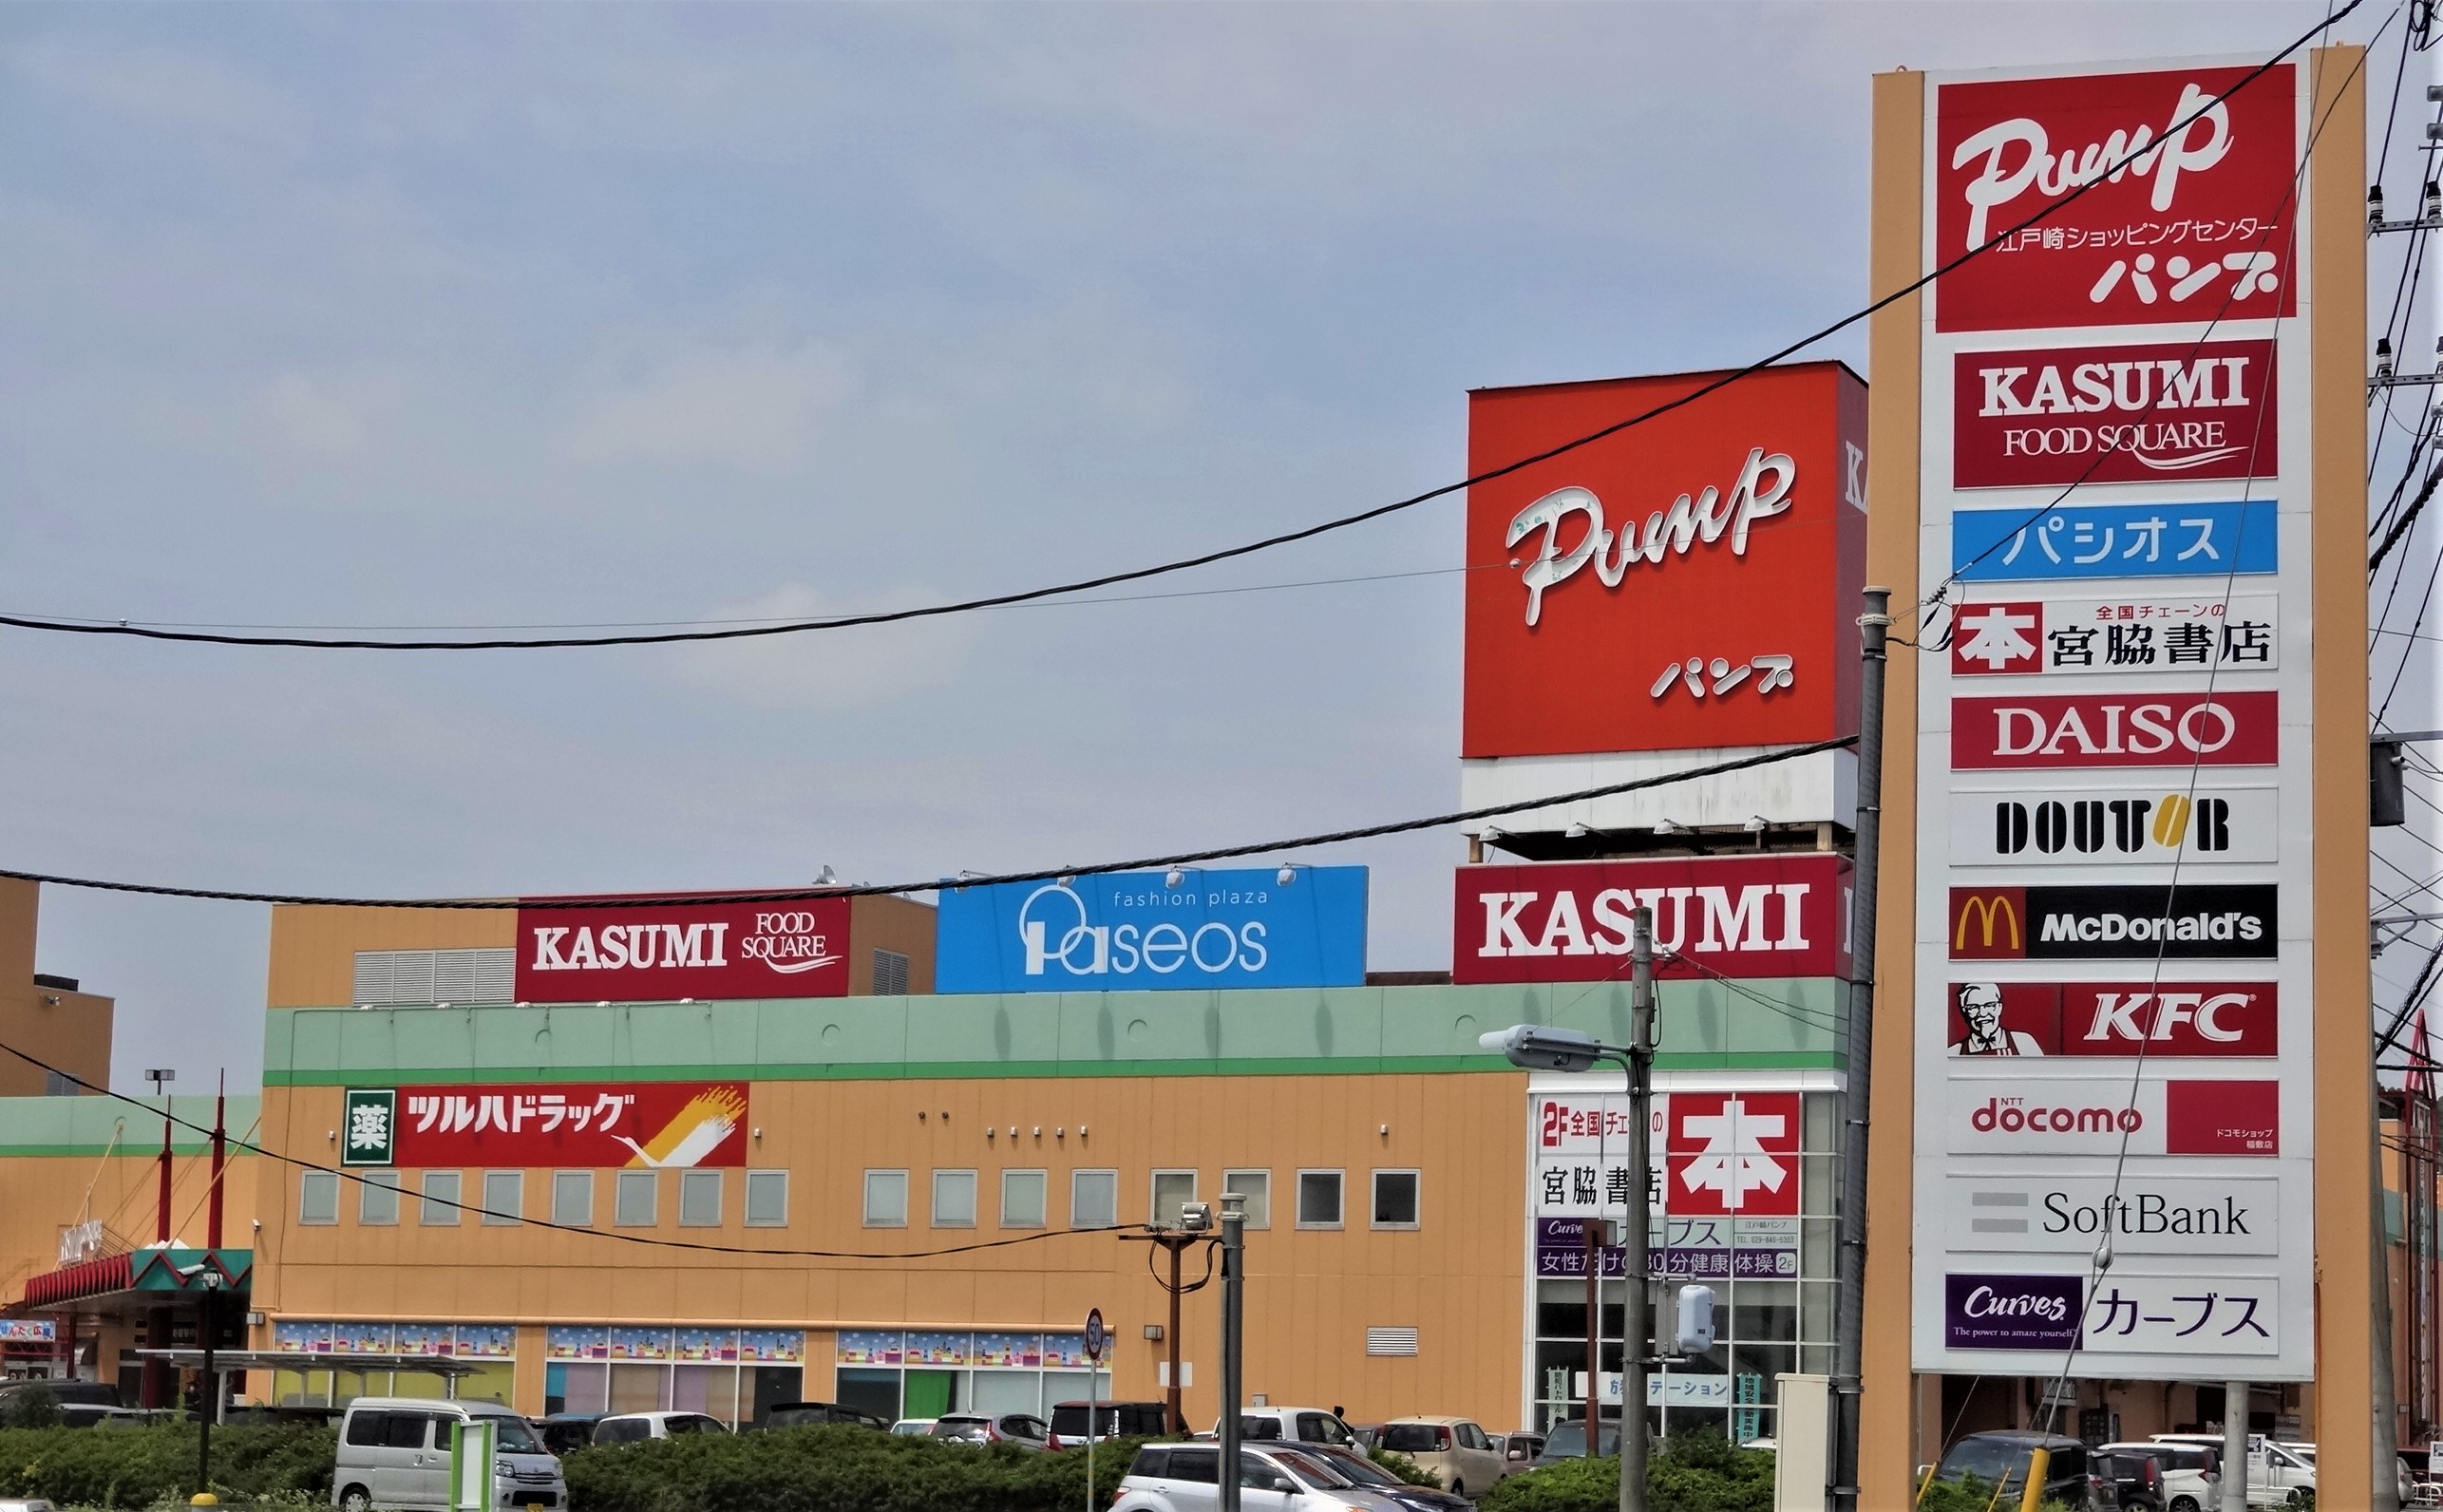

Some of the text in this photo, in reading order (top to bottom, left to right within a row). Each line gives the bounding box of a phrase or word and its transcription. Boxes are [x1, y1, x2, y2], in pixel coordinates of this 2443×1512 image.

[1952, 83, 2235, 253] Pump
[1997, 217, 2278, 253] 江戸崎ショッピングセンター
[2090, 251, 2279, 304] パンプ
[1979, 356, 2250, 417] KASUMI
[2003, 421, 2242, 465] FOOD SQUARE
[1506, 446, 1796, 627] Pump
[2001, 516, 2220, 566] パシオス
[2095, 603, 2226, 621] 全国チェーンの
[1958, 607, 2037, 670] 本
[2048, 620, 2272, 667] 宮脇書店
[1650, 653, 1794, 698] パンプ
[1992, 702, 2236, 756] DAISO
[1997, 793, 2229, 854] DOUTOR
[1113, 890, 1268, 907] fashion plaza
[1478, 882, 1810, 957] KASUMI
[755, 912, 815, 935] FOOD
[2040, 912, 2263, 942] McDonald's
[532, 922, 729, 971] KASUMI
[741, 935, 836, 969] SQUARE
[2083, 992, 2250, 1043] KFC
[407, 1092, 635, 1134] ツルハドラッグ
[1543, 1101, 1663, 1146] 2F 全国チェの
[1971, 1097, 2144, 1133] docomo
[2000, 1097, 2024, 1106] NTT
[350, 1105, 388, 1150] 薬
[2216, 1128, 2274, 1138] ドコモショップ
[1679, 1100, 1788, 1209] 本
[1547, 1220, 1583, 1235] Curve
[2043, 1192, 2251, 1235] SoftBank
[1964, 1285, 2067, 1321] Curves
[2093, 1288, 2270, 1338] カーブス
[1953, 1326, 1971, 1336] The
[1972, 1329, 1998, 1338] power
